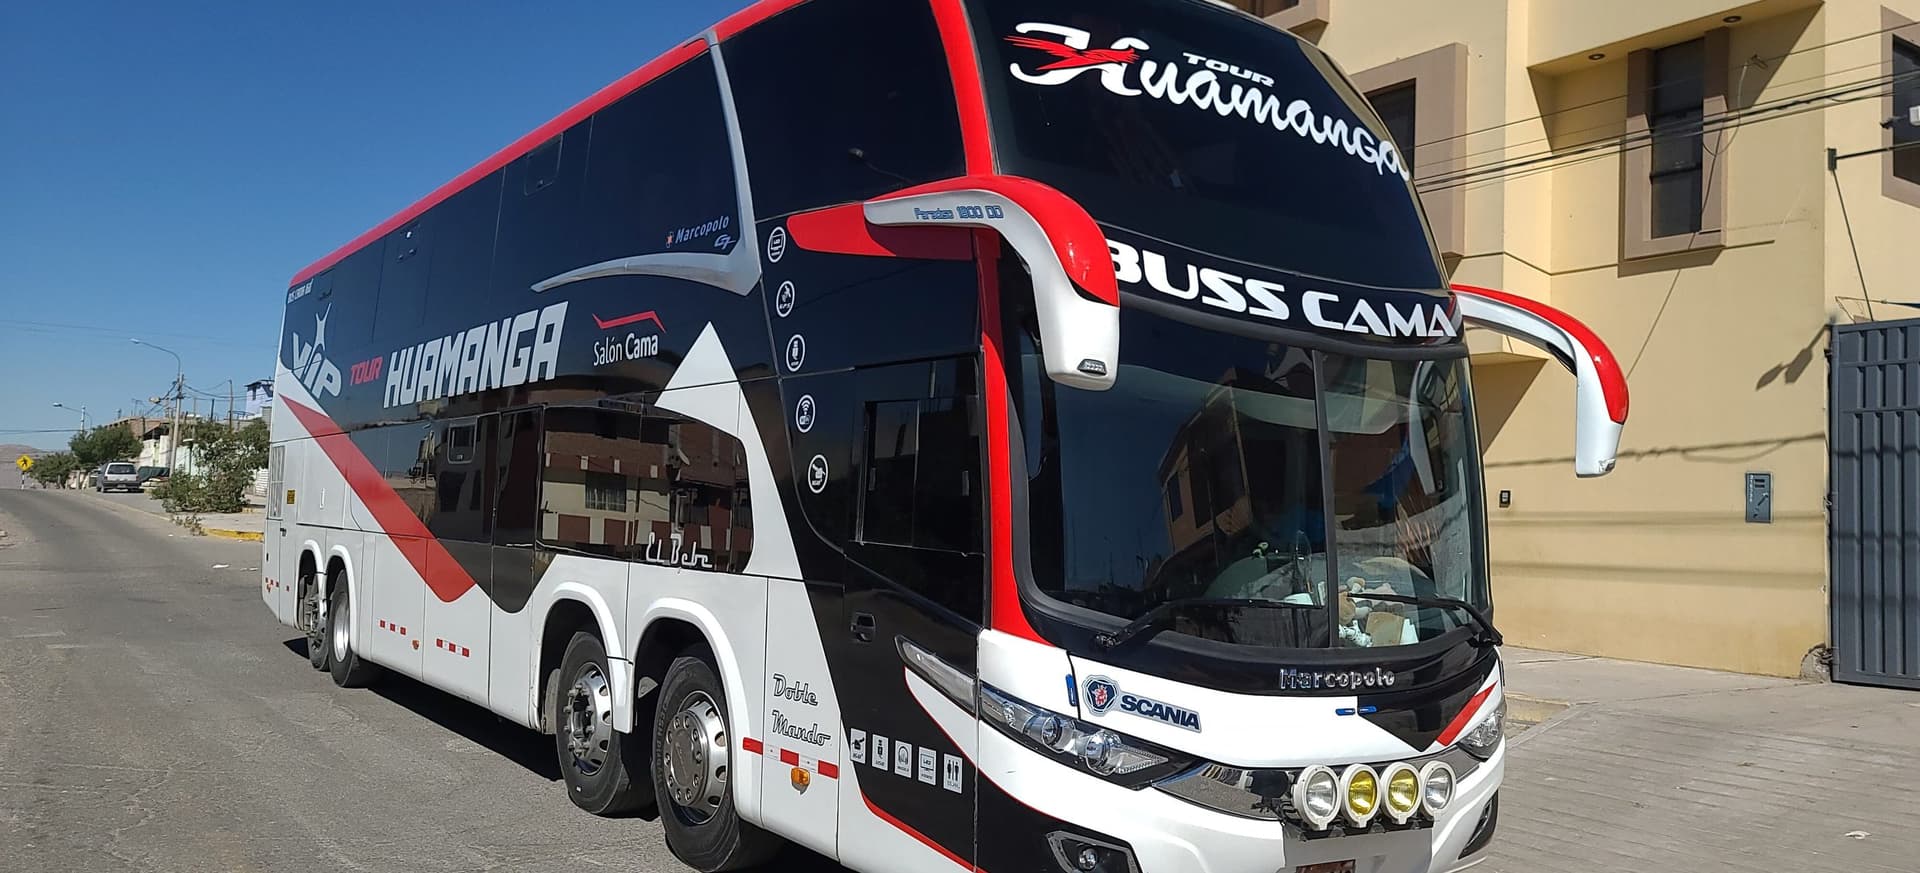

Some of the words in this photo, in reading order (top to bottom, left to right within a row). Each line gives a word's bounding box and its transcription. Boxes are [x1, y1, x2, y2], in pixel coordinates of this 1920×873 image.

[1182, 52, 1275, 88] TOUR
[675, 215, 729, 244] Marcopolo
[1105, 238, 1290, 321] BUSS
[1301, 290, 1457, 337] CAMA
[350, 356, 383, 387] TOUR
[383, 300, 569, 409] HUAMANGA
[593, 336, 623, 366] Salón
[625, 332, 659, 360] Cama
[645, 531, 665, 563] El
[772, 672, 819, 707] Doble
[1280, 667, 1395, 690] Marcopolo
[771, 709, 831, 747] Mando
[1120, 694, 1200, 730] SCANIA
